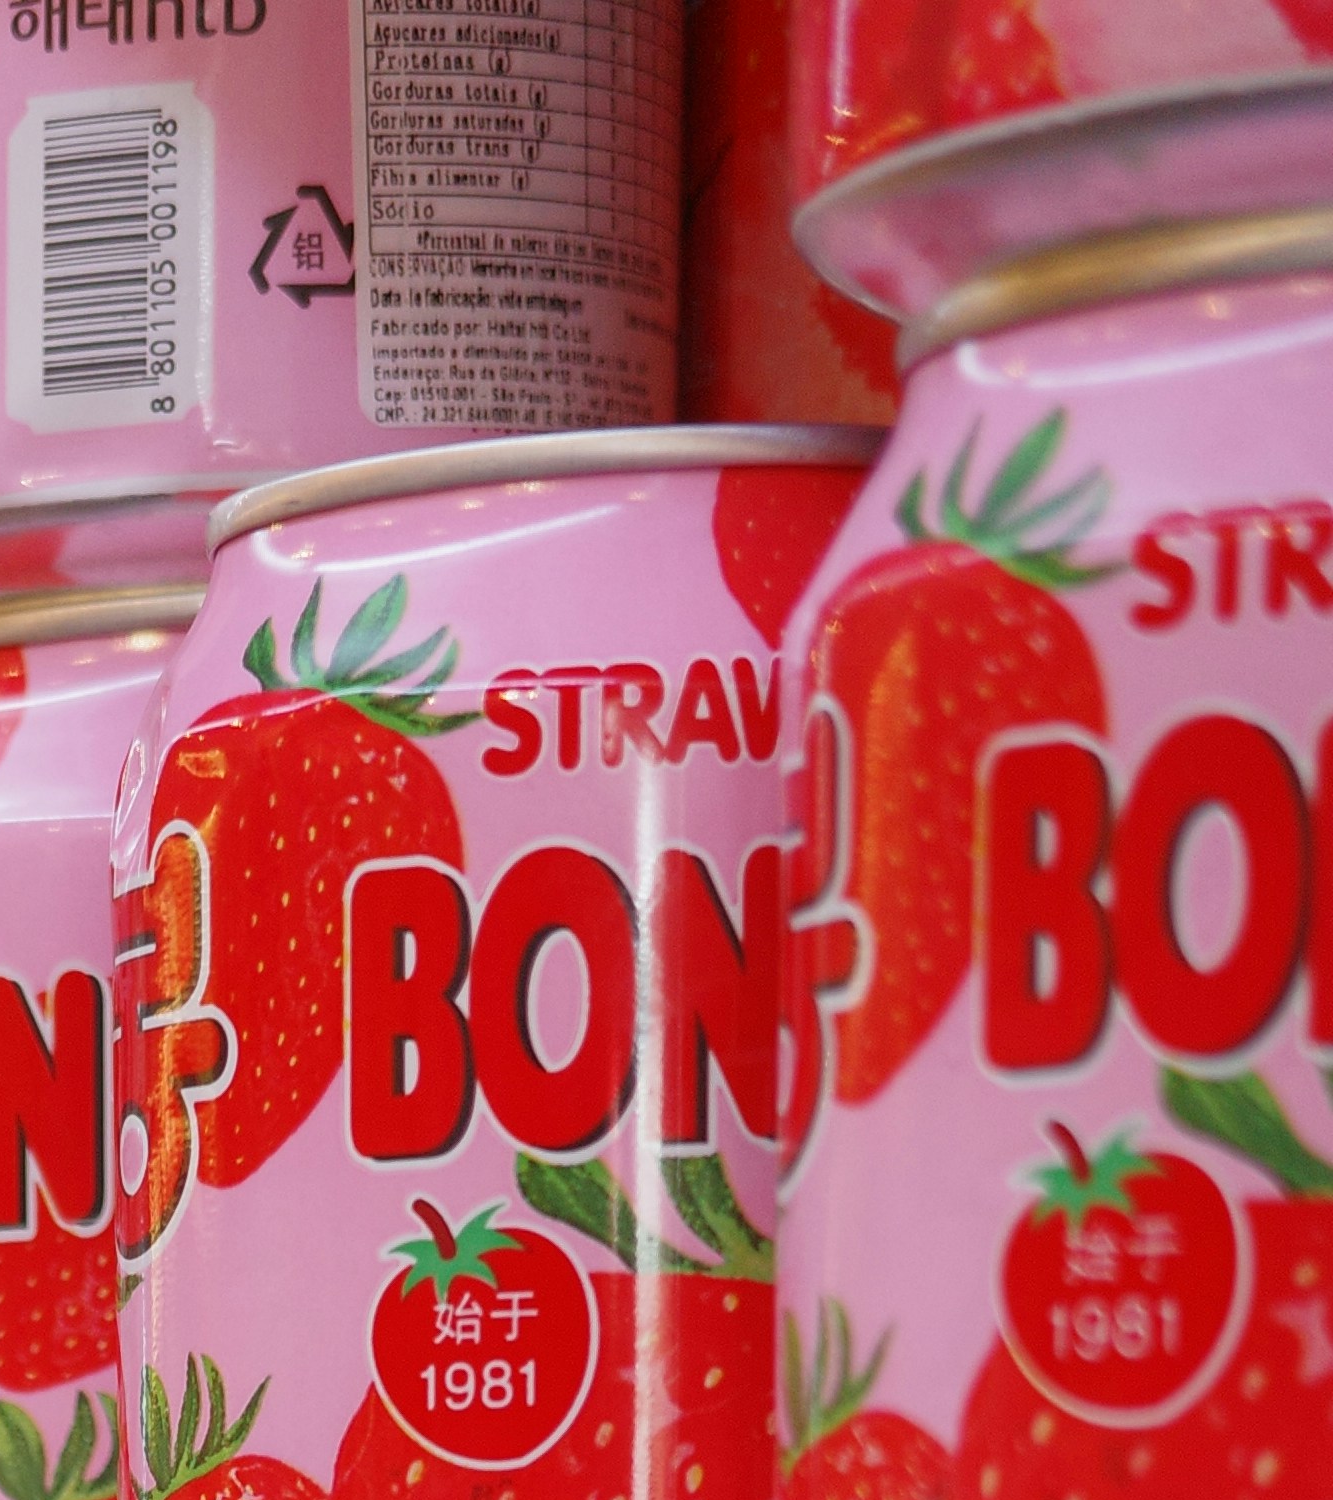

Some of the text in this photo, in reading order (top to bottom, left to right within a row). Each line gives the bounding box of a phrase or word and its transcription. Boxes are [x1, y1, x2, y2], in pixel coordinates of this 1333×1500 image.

[151, 118, 178, 413] 8 801105 001198
[293, 231, 325, 271] 铝
[371, 319, 448, 336] Fabrcado
[978, 705, 1333, 1082] BO
[348, 840, 779, 1162] BON
[433, 1290, 539, 1345] 始于
[1049, 1297, 1182, 1362] 1981
[419, 1360, 539, 1412] 1981
